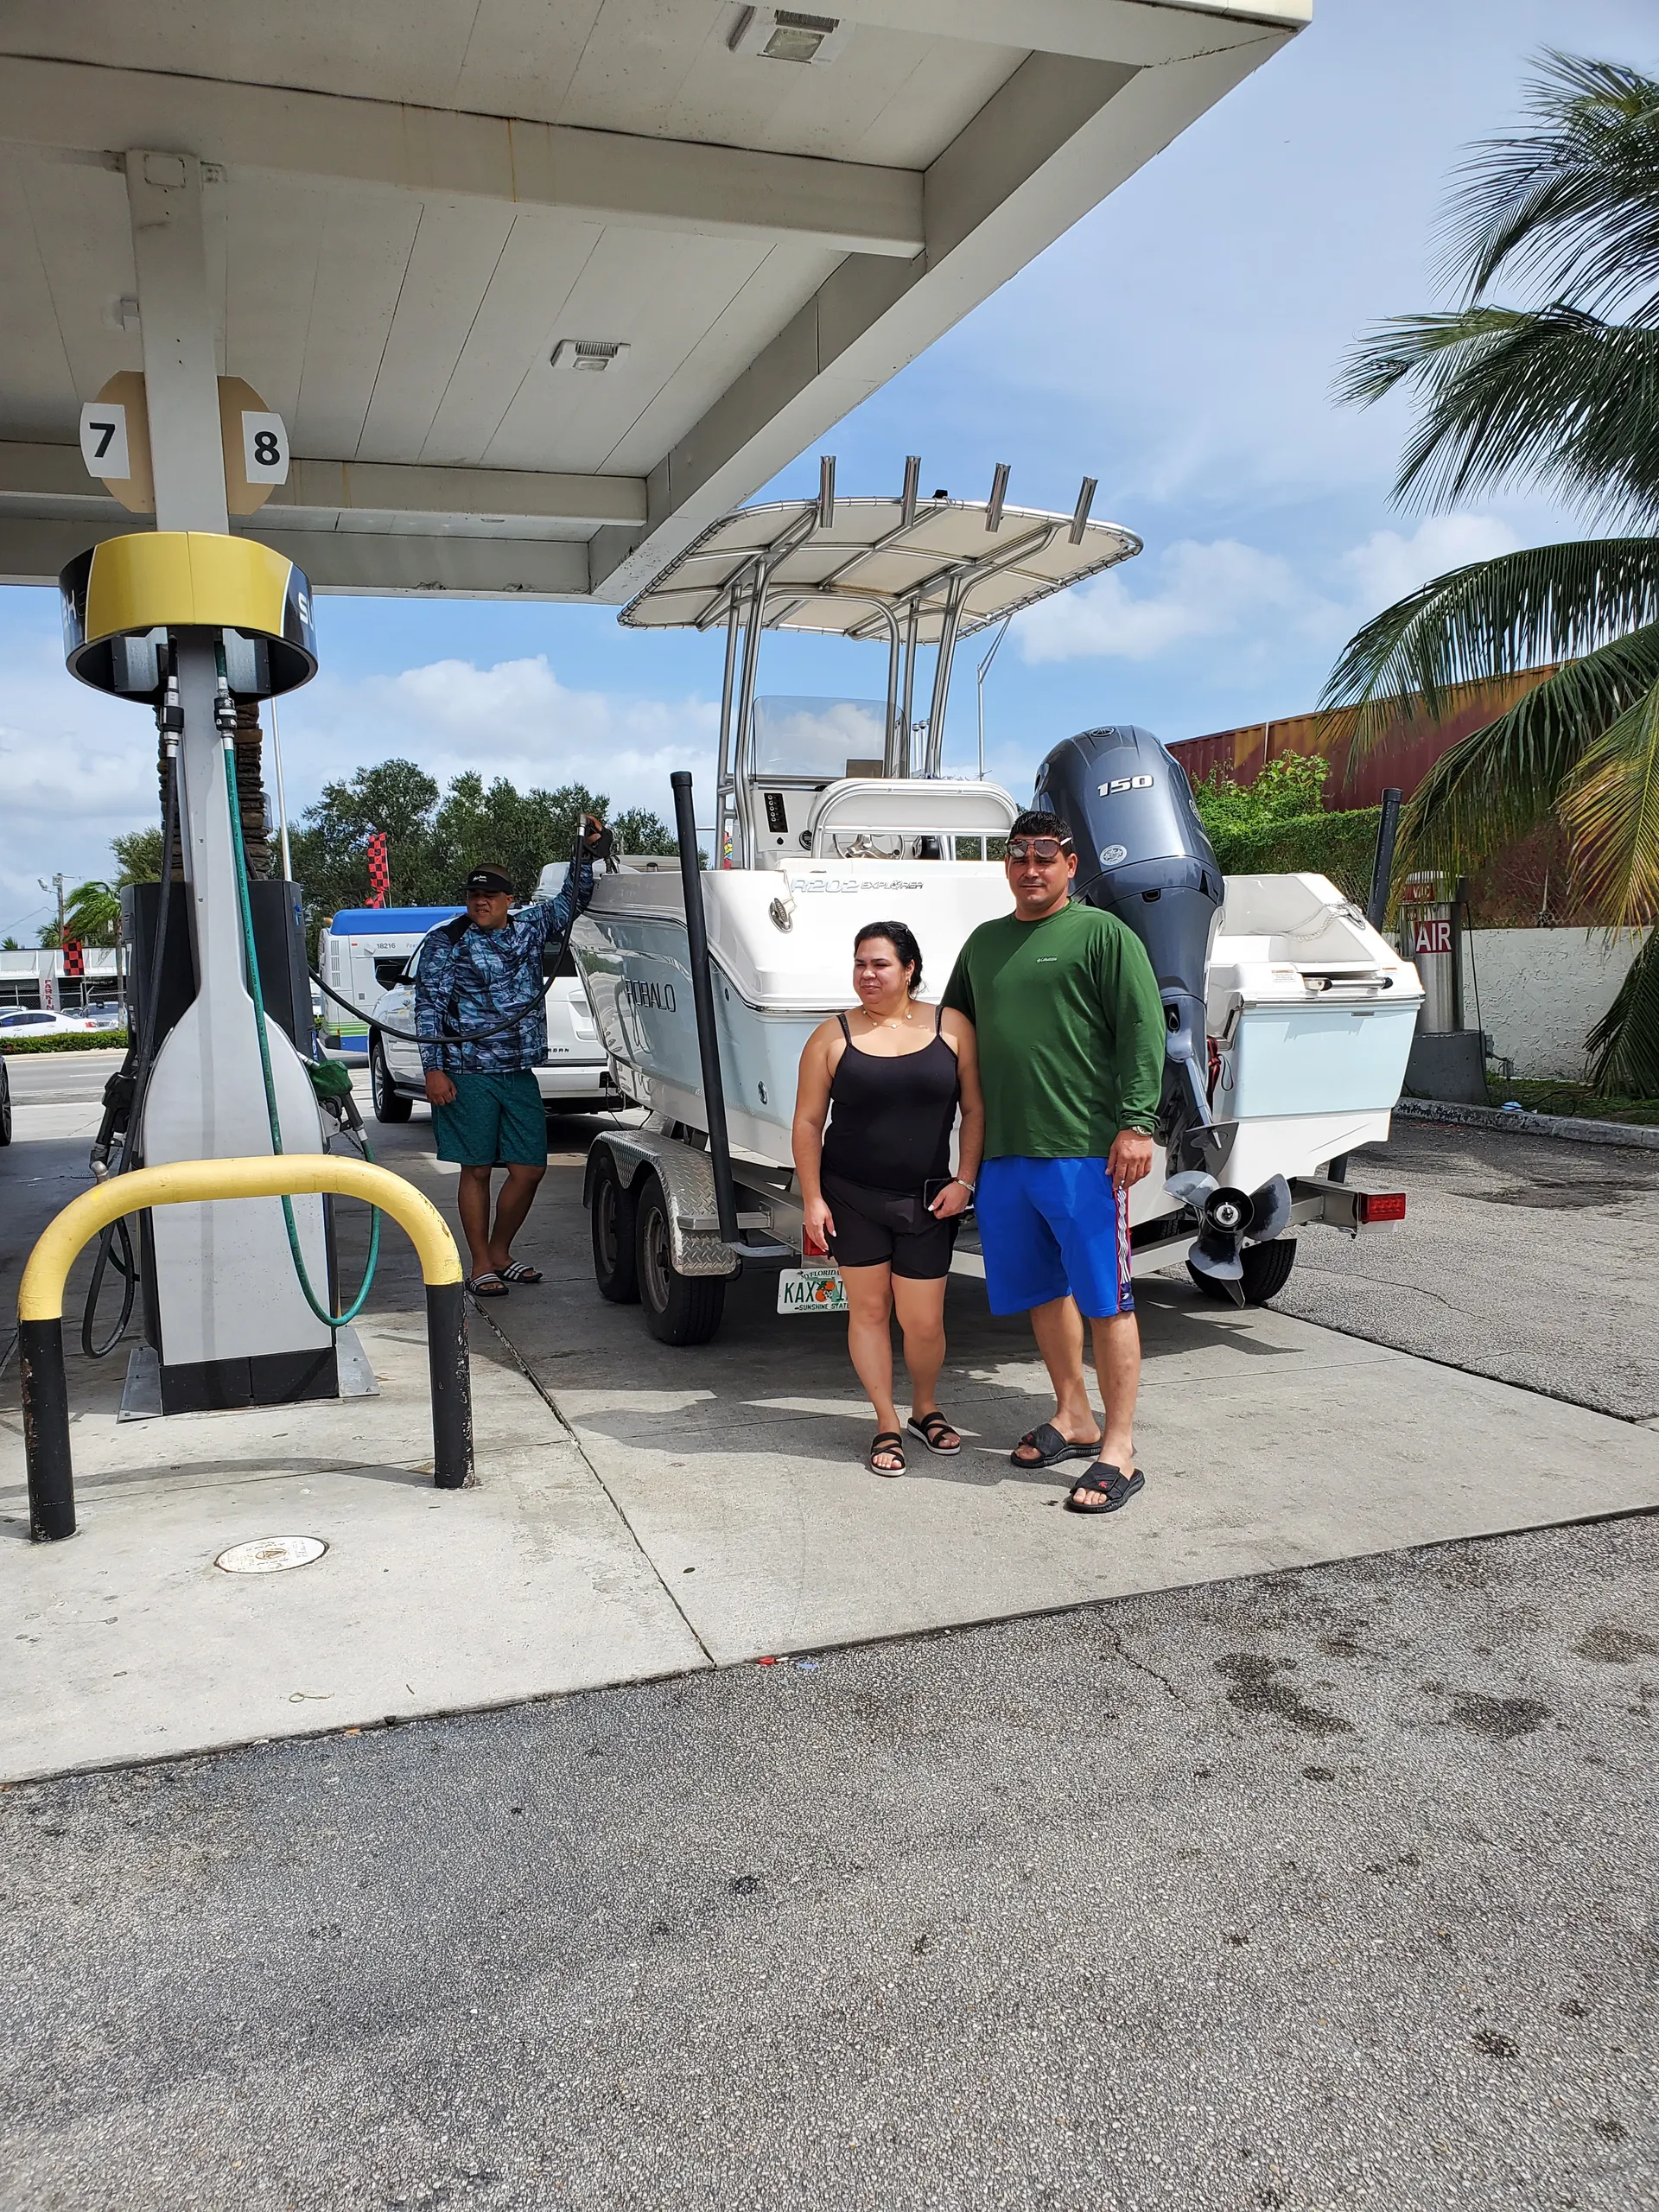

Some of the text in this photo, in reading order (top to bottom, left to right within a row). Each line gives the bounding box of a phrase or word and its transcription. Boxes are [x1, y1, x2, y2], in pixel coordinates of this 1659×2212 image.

[89, 422, 116, 458] 7
[254, 430, 281, 466] 8
[1096, 774, 1154, 798] 150
[791, 878, 859, 893] R202
[1415, 922, 1452, 952] AIR
[45, 979, 55, 1010] PARKIN
[625, 978, 677, 1013] ROBALO
[784, 1281, 816, 1304] KAX
